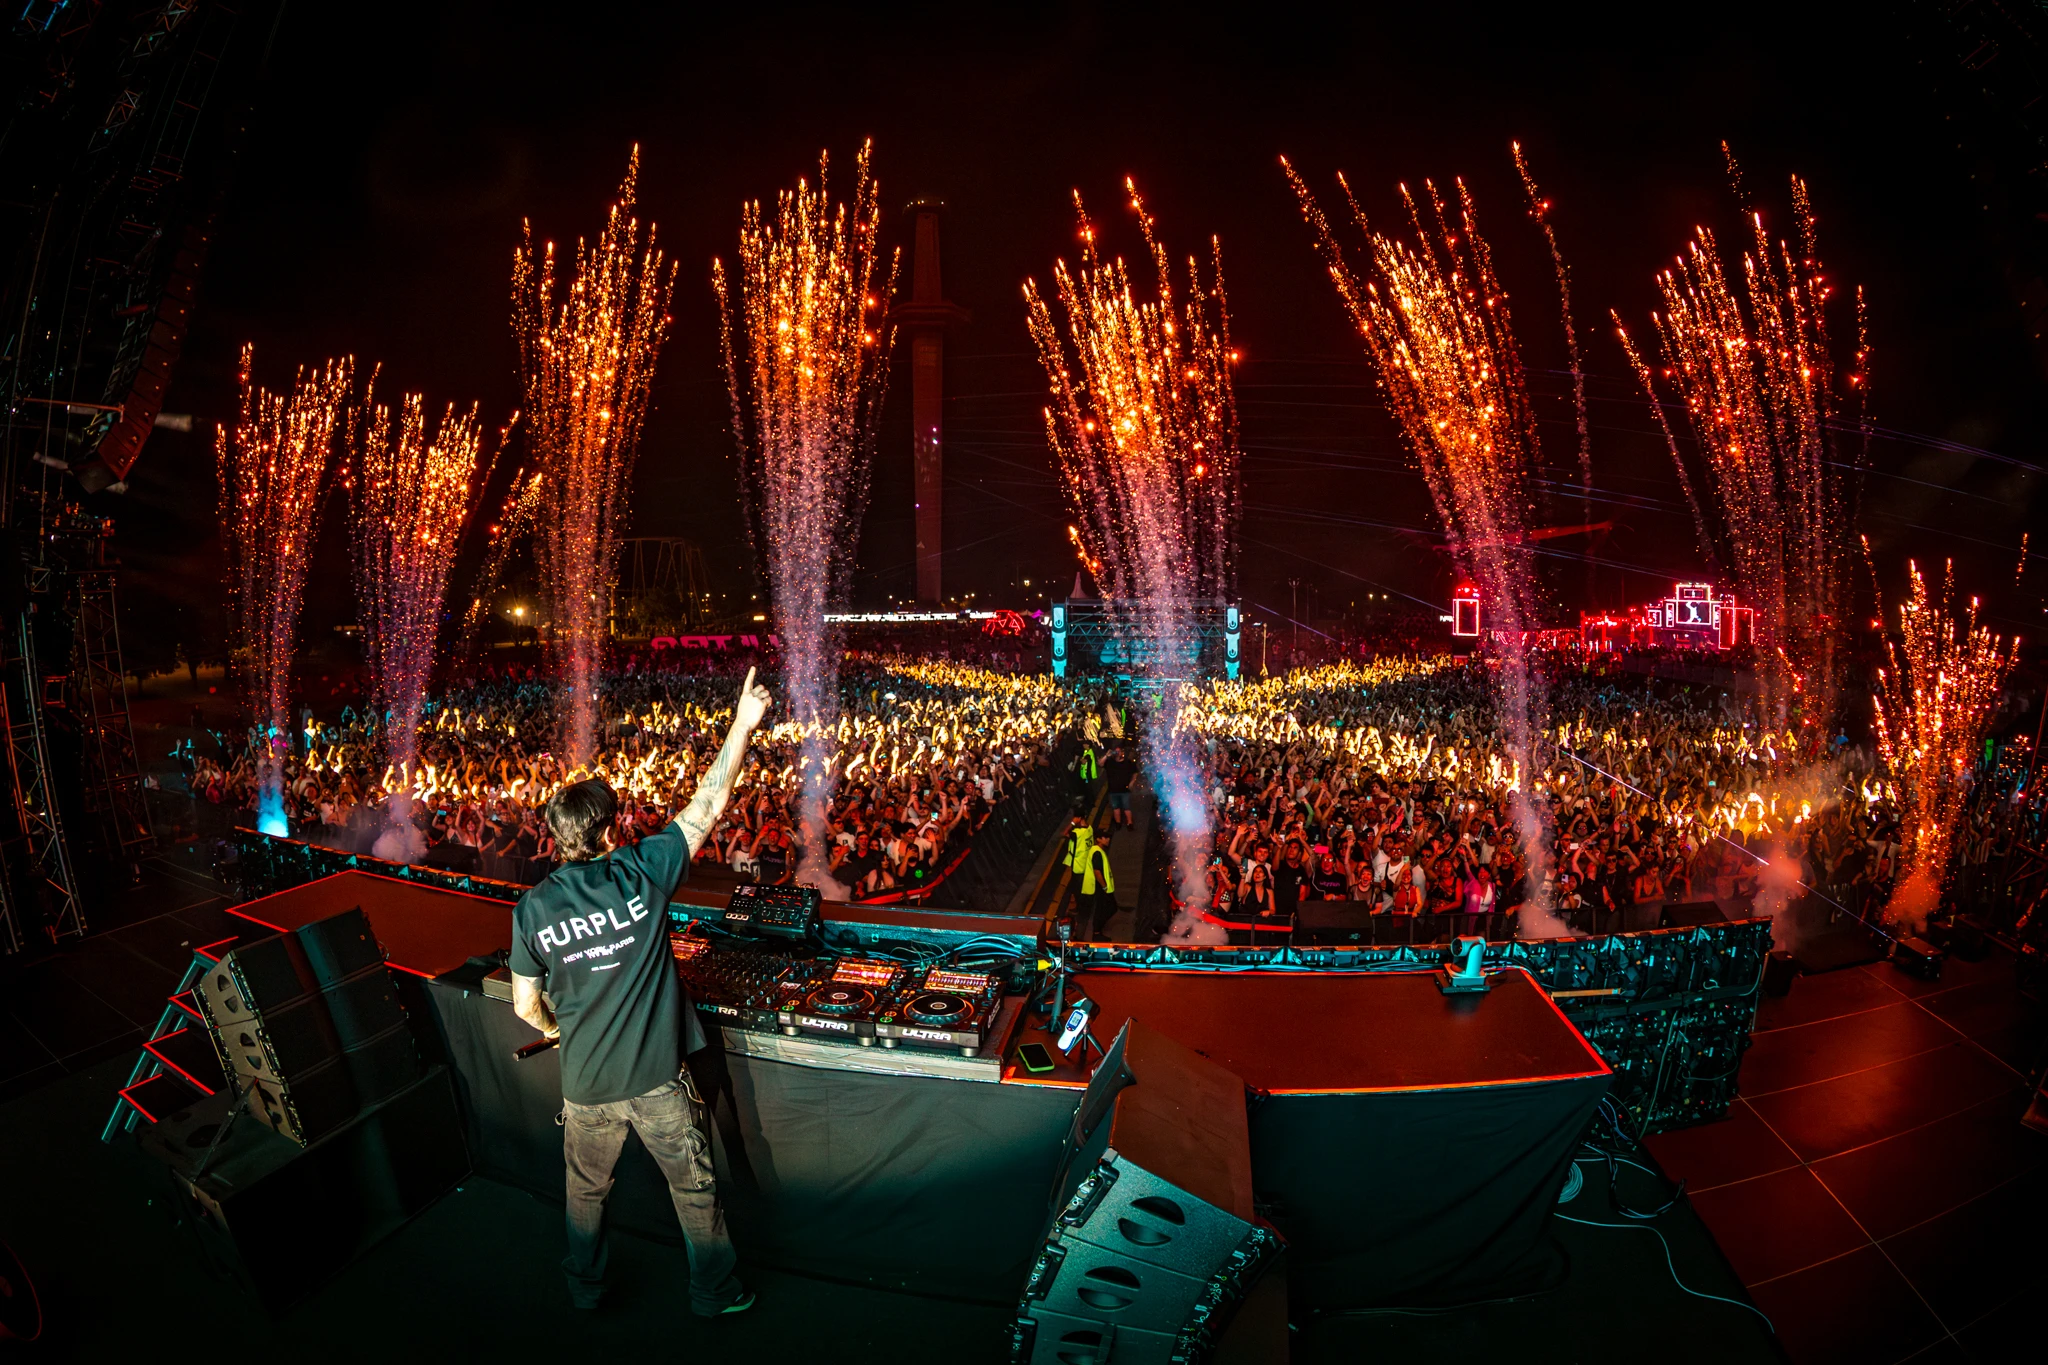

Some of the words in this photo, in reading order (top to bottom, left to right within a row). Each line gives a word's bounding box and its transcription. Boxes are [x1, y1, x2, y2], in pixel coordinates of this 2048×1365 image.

[562, 951, 584, 964] NEW
[608, 935, 636, 951] PARIS
[696, 1002, 738, 1016] ULTRA
[801, 1016, 849, 1031] ULTRA
[901, 1027, 952, 1041] ULTRA
